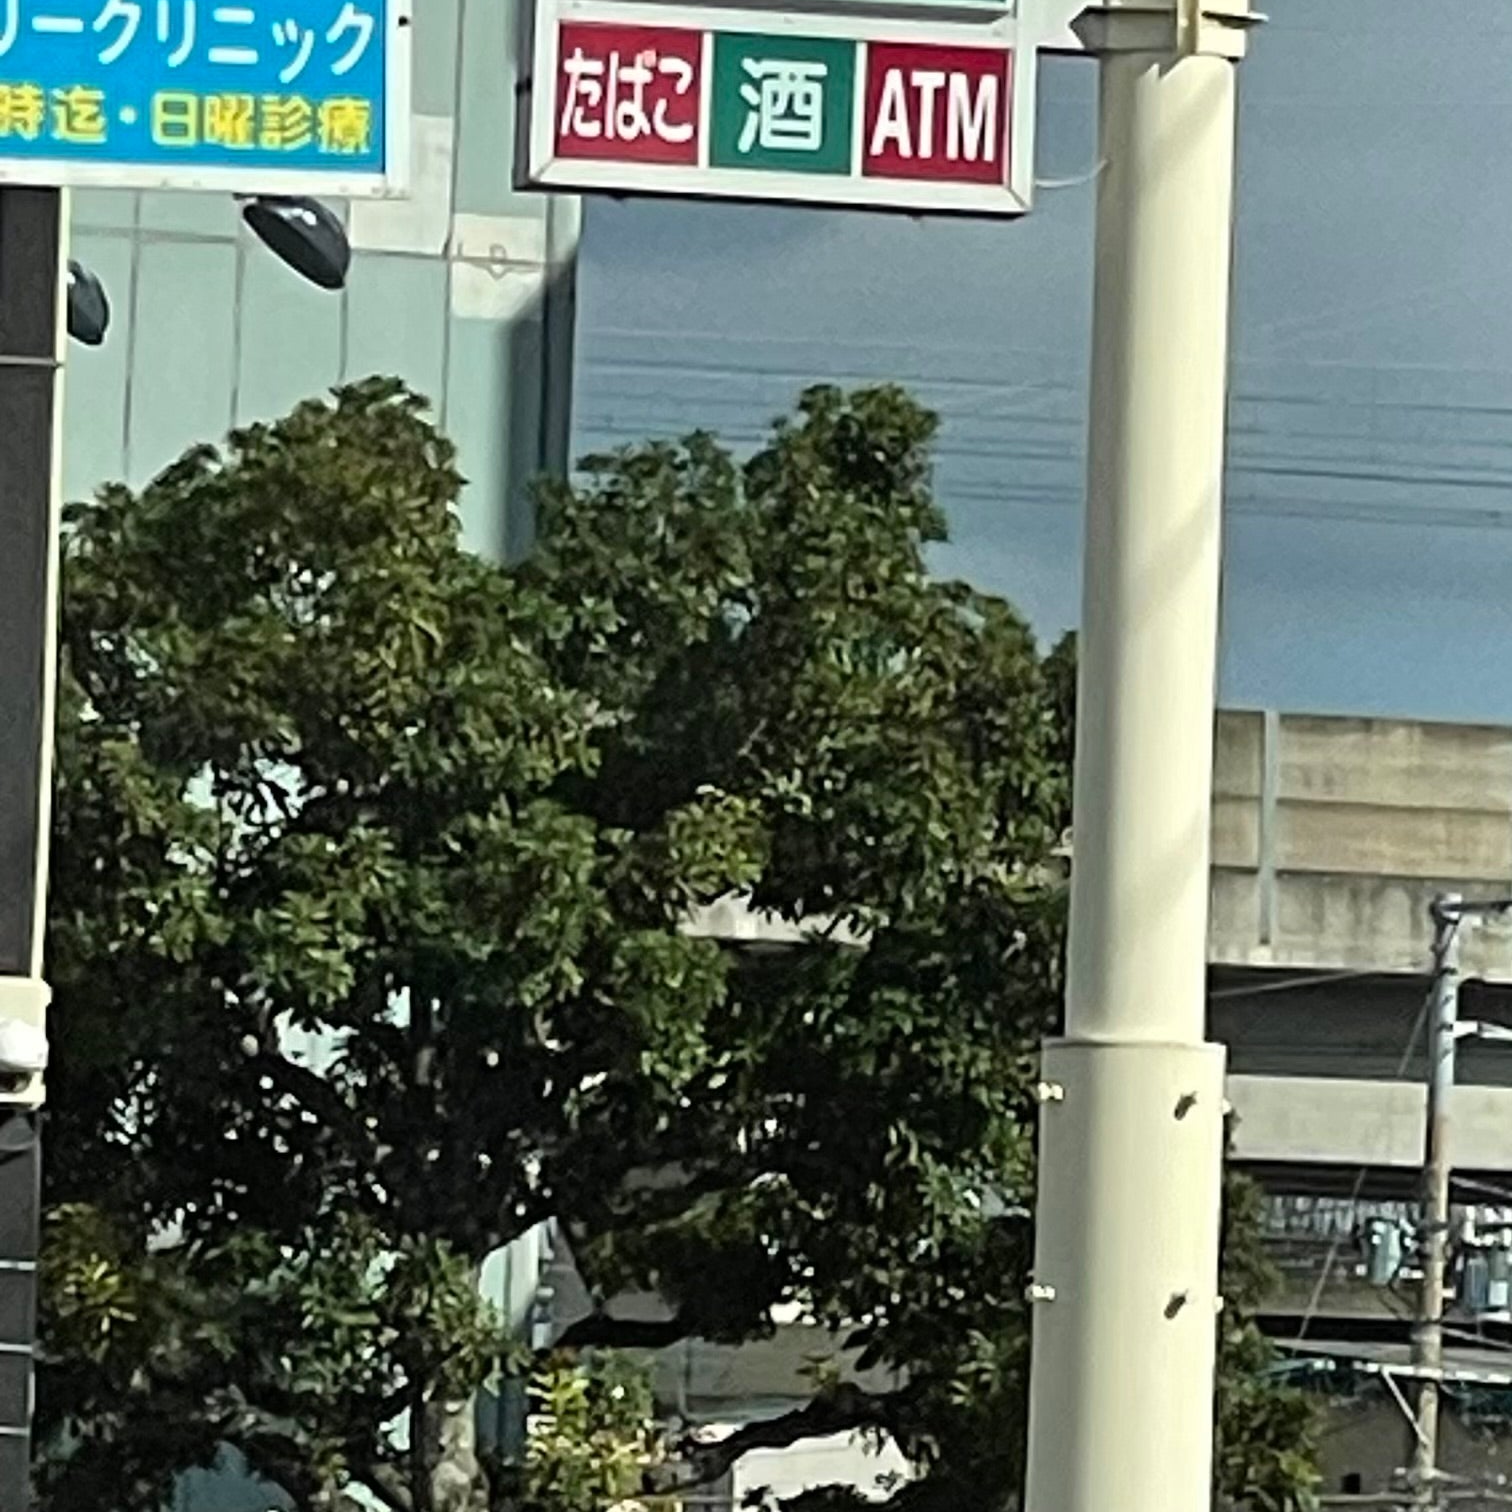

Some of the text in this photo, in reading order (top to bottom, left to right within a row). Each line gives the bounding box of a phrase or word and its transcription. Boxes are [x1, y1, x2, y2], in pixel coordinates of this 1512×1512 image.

[561, 47, 694, 143] たばこ
[738, 57, 828, 153] 酒
[869, 68, 999, 163] ATM
